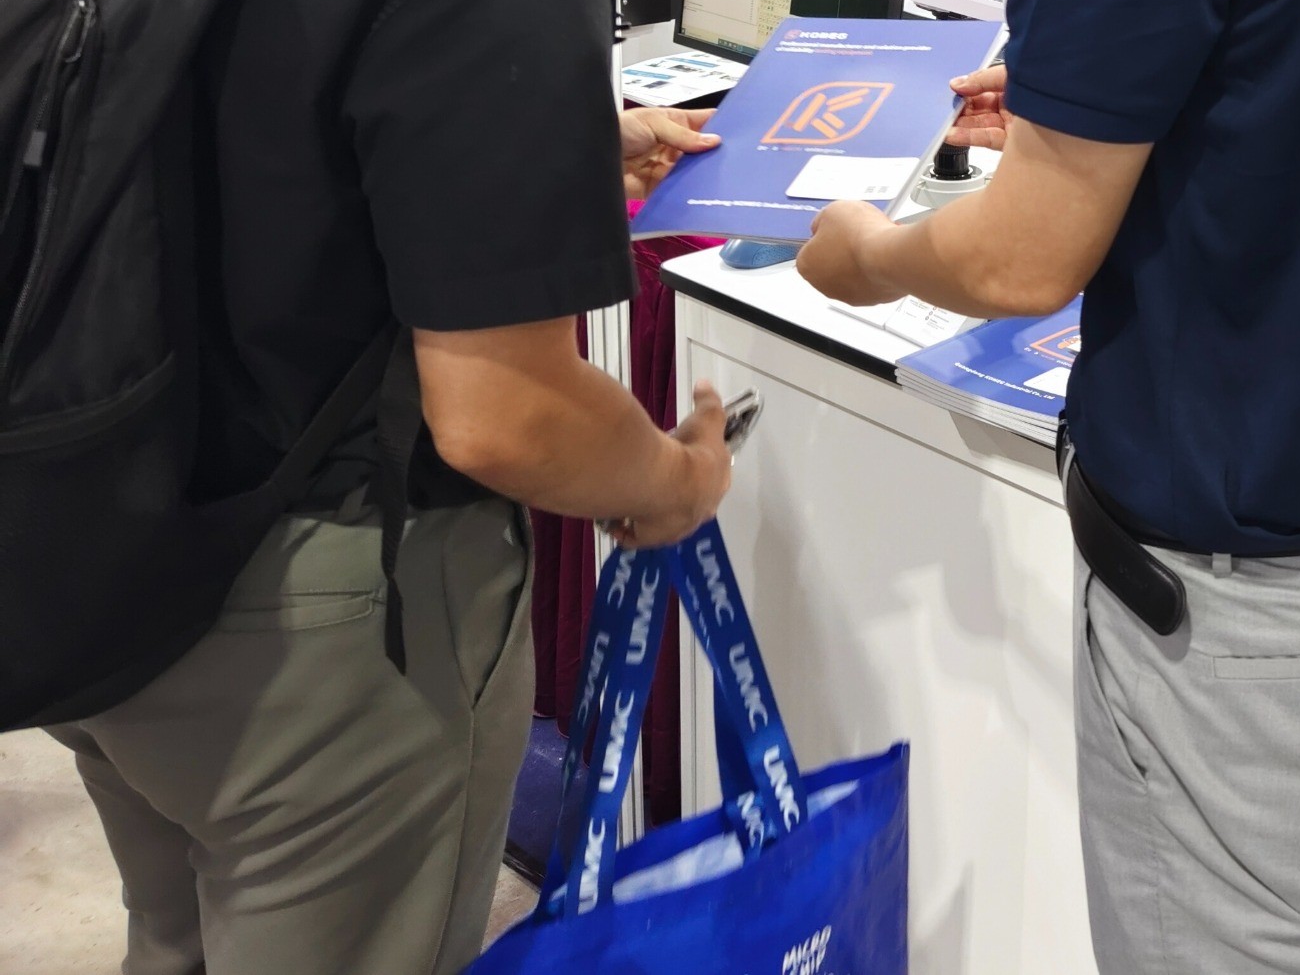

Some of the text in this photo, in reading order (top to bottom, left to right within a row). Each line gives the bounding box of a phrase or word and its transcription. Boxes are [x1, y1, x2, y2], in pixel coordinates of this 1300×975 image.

[626, 566, 660, 665] UMC
[695, 537, 735, 627] UMC
[728, 642, 769, 732] UMC
[598, 690, 635, 795] UMC
[762, 744, 800, 833] UMC
[578, 818, 606, 916] UMC
